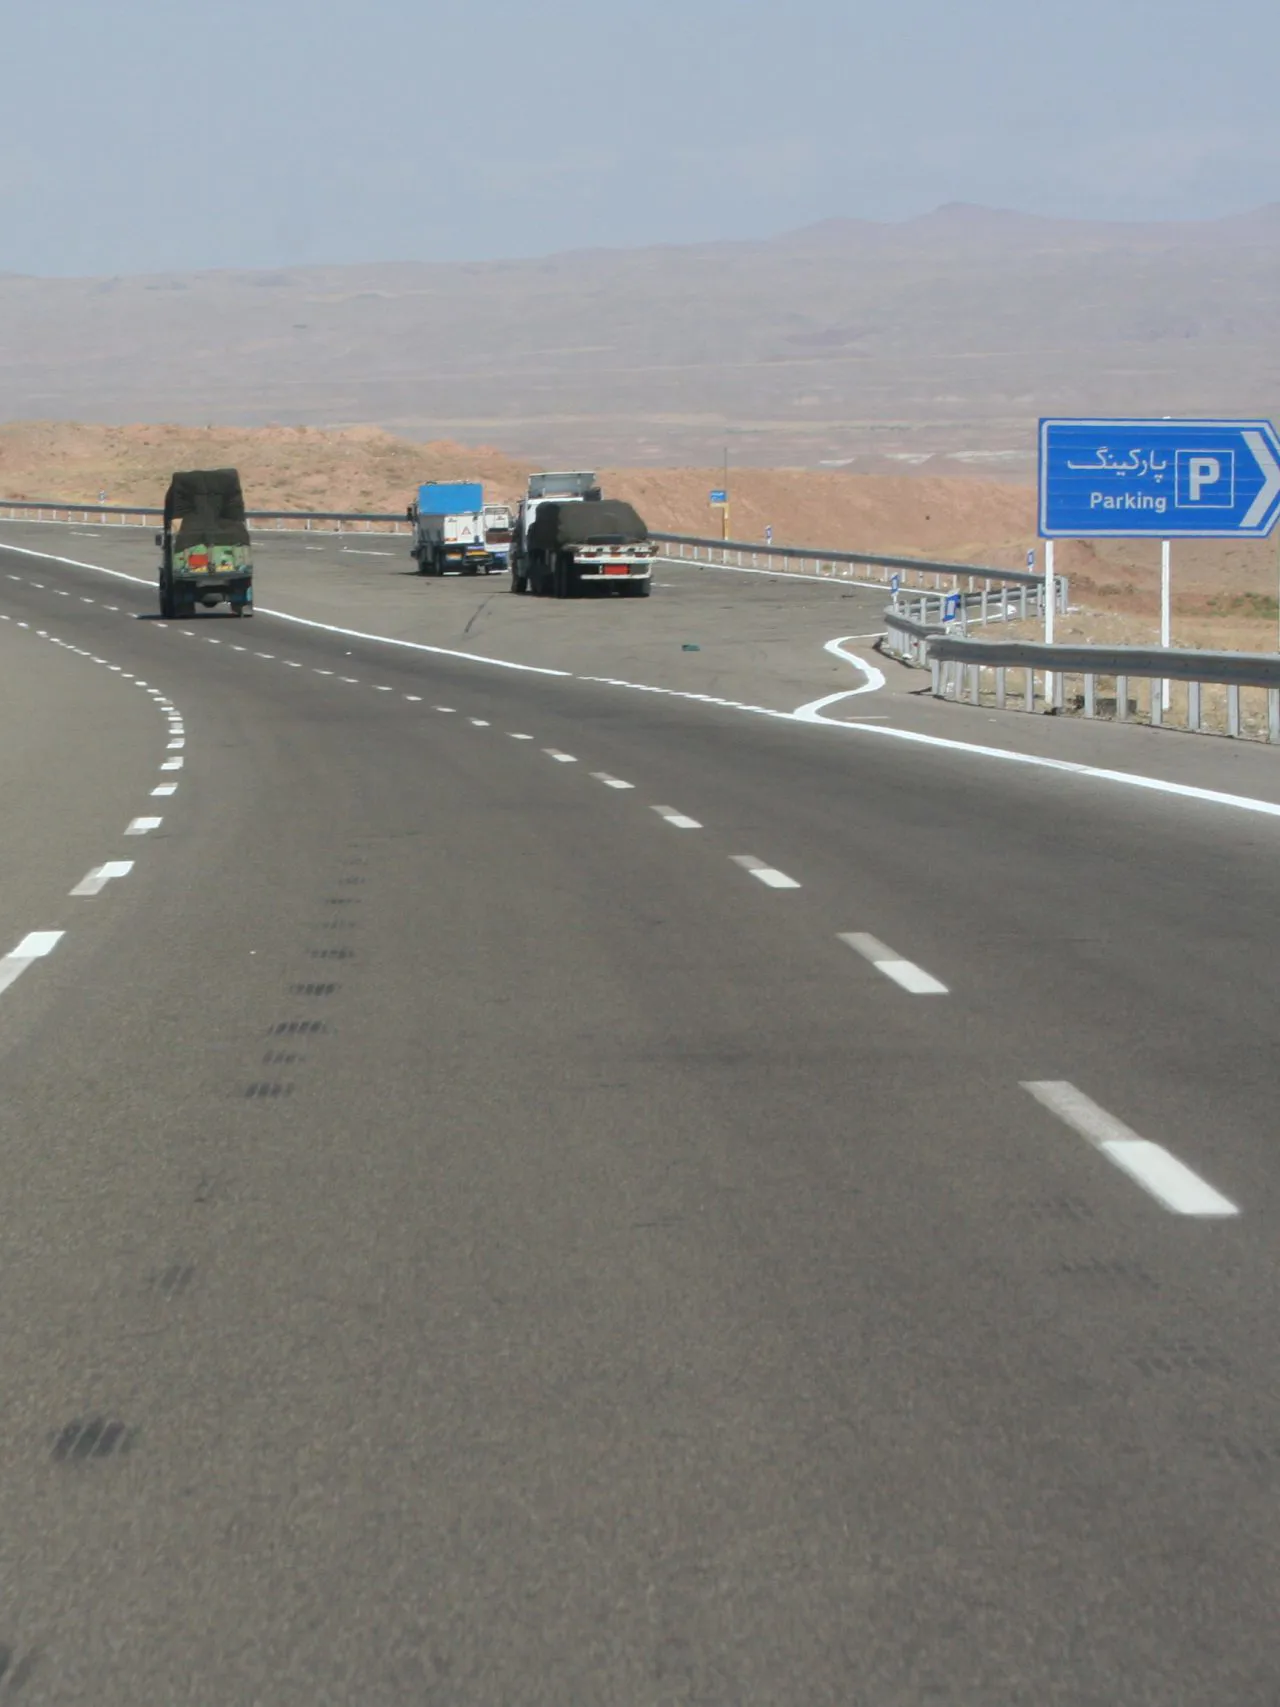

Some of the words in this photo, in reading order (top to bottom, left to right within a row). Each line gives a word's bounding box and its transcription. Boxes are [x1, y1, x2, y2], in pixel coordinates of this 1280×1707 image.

[1066, 446, 1167, 483] پارکینگ
[1189, 457, 1220, 501] P
[1090, 491, 1167, 513] Parking
